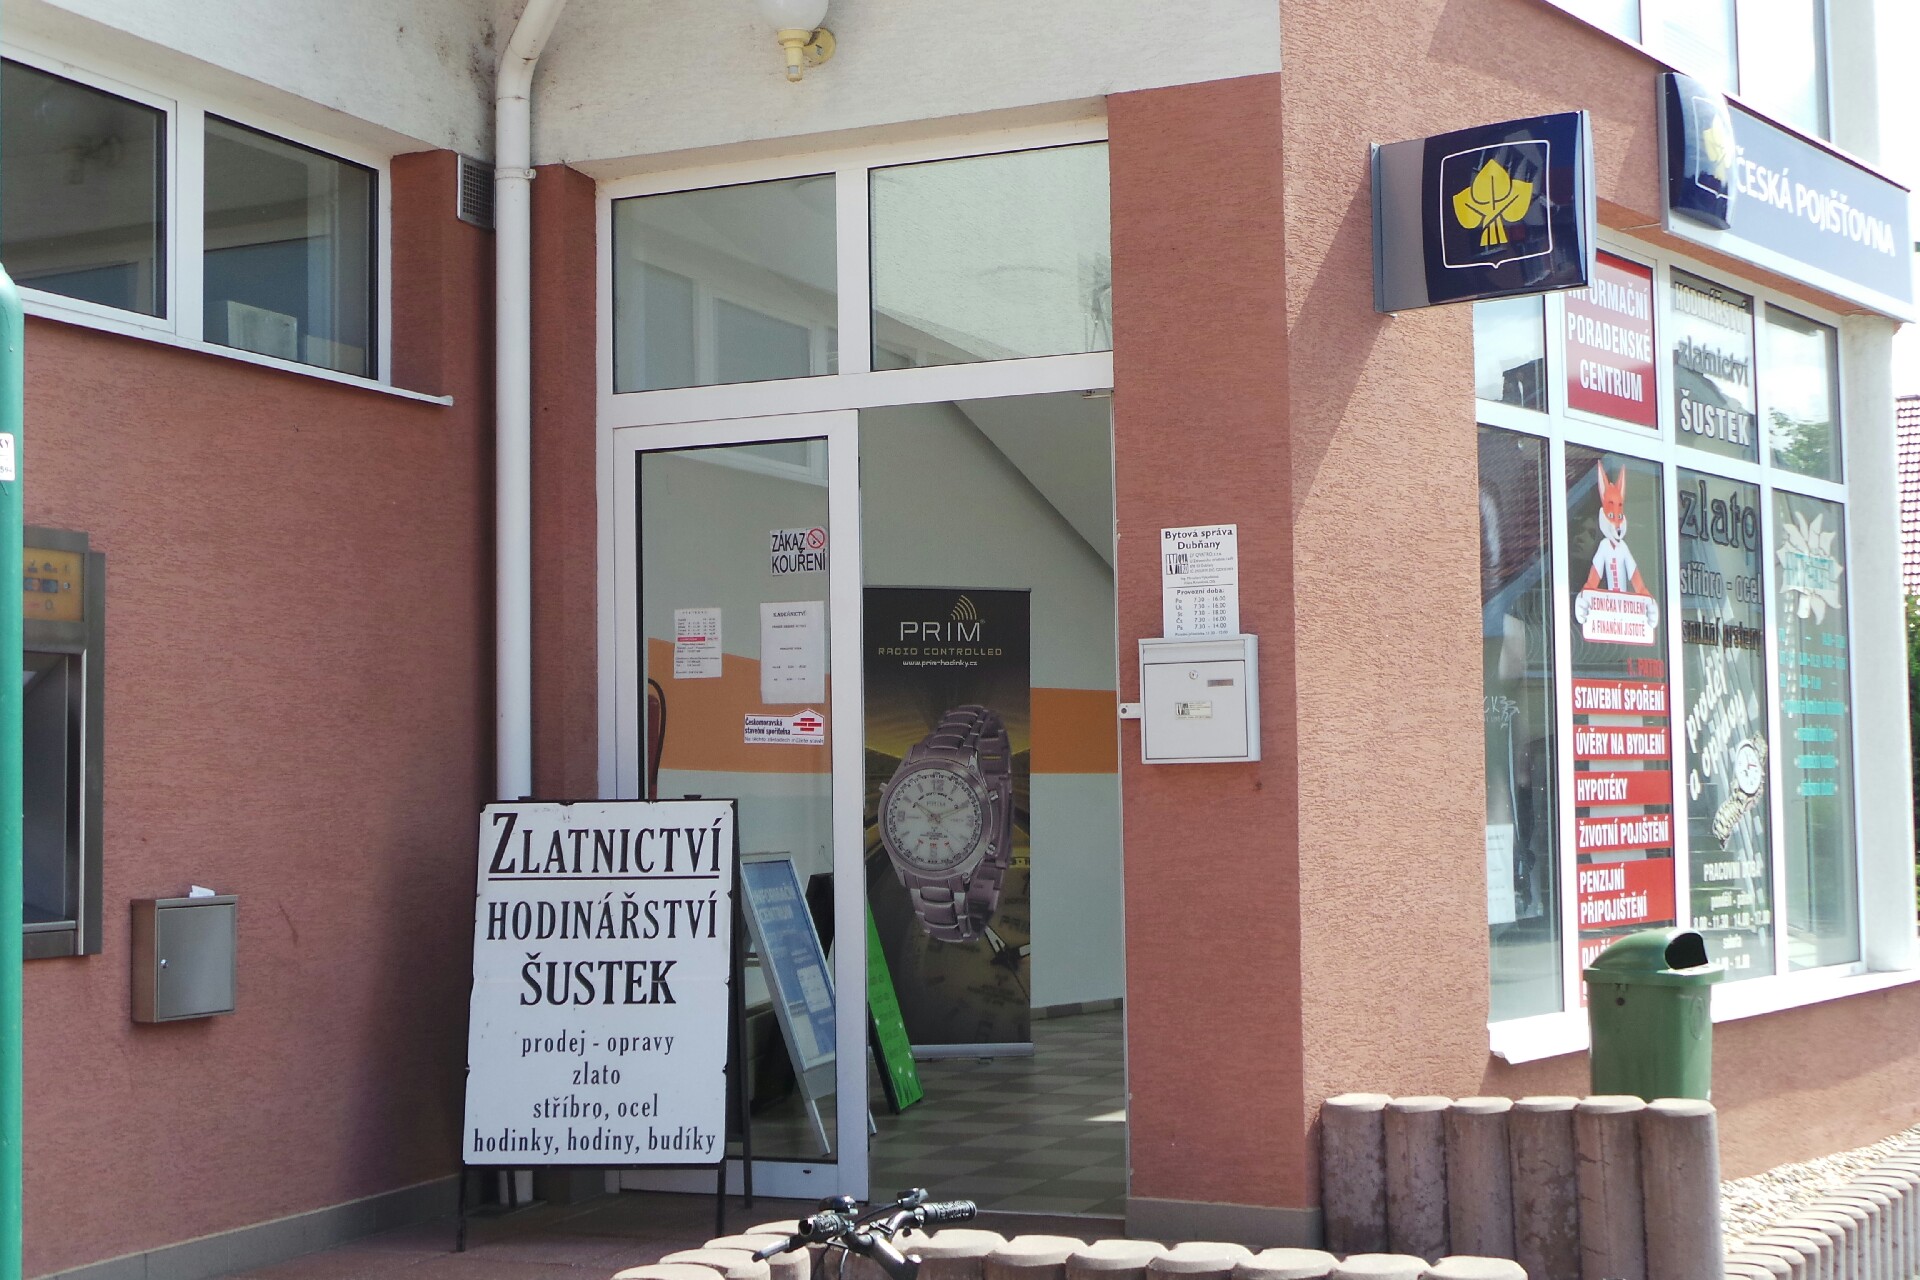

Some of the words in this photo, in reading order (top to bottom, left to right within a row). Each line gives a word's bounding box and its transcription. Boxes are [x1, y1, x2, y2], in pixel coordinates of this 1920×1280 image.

[1735, 145, 1793, 213] ČESKÁ
[1795, 182, 1896, 257] POJIŠŤOVNA
[1568, 278, 1648, 320] ORMAČNÍ
[1567, 311, 1651, 363] PORADENSKÉ
[1580, 358, 1643, 402] CENTRUM
[1680, 388, 1750, 446] ŠUSTEK
[1679, 480, 1757, 551] zlato
[771, 530, 806, 553] ZÁKAZ
[1165, 529, 1198, 541] Bytová
[1201, 527, 1233, 539] správa
[1178, 540, 1220, 550] Dubňany
[771, 549, 826, 574] KOUŘENÍ
[1680, 561, 1723, 600] stříbro
[1735, 572, 1762, 604] ocel
[1590, 596, 1617, 612] JEDNIČKA
[900, 621, 980, 642] PRIM
[1597, 618, 1623, 636] FINANČNÍ
[878, 647, 918, 656] RADIO
[924, 648, 1002, 656] CONTROLLED
[1574, 683, 1622, 711] STAVEBNÍ
[1624, 684, 1665, 711] SPOŘENÍ
[745, 717, 783, 726] Českomoravská
[1576, 727, 1610, 755] ÚVĚRY
[1611, 733, 1624, 755] NA
[1626, 729, 1665, 756] BYDLENÍ
[1577, 774, 1628, 800] HYPOTÉKY
[488, 813, 722, 875] ZLATNICTVÍ
[1579, 817, 1618, 848] ŽIVOTNÍ
[1620, 818, 1668, 845] POJIŠTĚNÍ
[1580, 862, 1624, 893] PENZIJNÍ
[486, 890, 718, 941] HODINÁŘSTVÍ
[1580, 890, 1647, 924] PŘIPOJIŠTĚNÍ
[520, 952, 678, 1006] ŠUSTEK
[521, 1029, 586, 1058] prodej
[607, 1034, 675, 1056] opravy
[572, 1062, 621, 1085] zlato
[533, 1095, 610, 1122] stříbro,
[617, 1093, 658, 1118] ocel
[474, 1128, 559, 1155] hodinky,
[567, 1127, 640, 1154] hodiny,
[649, 1126, 716, 1154] budíky
